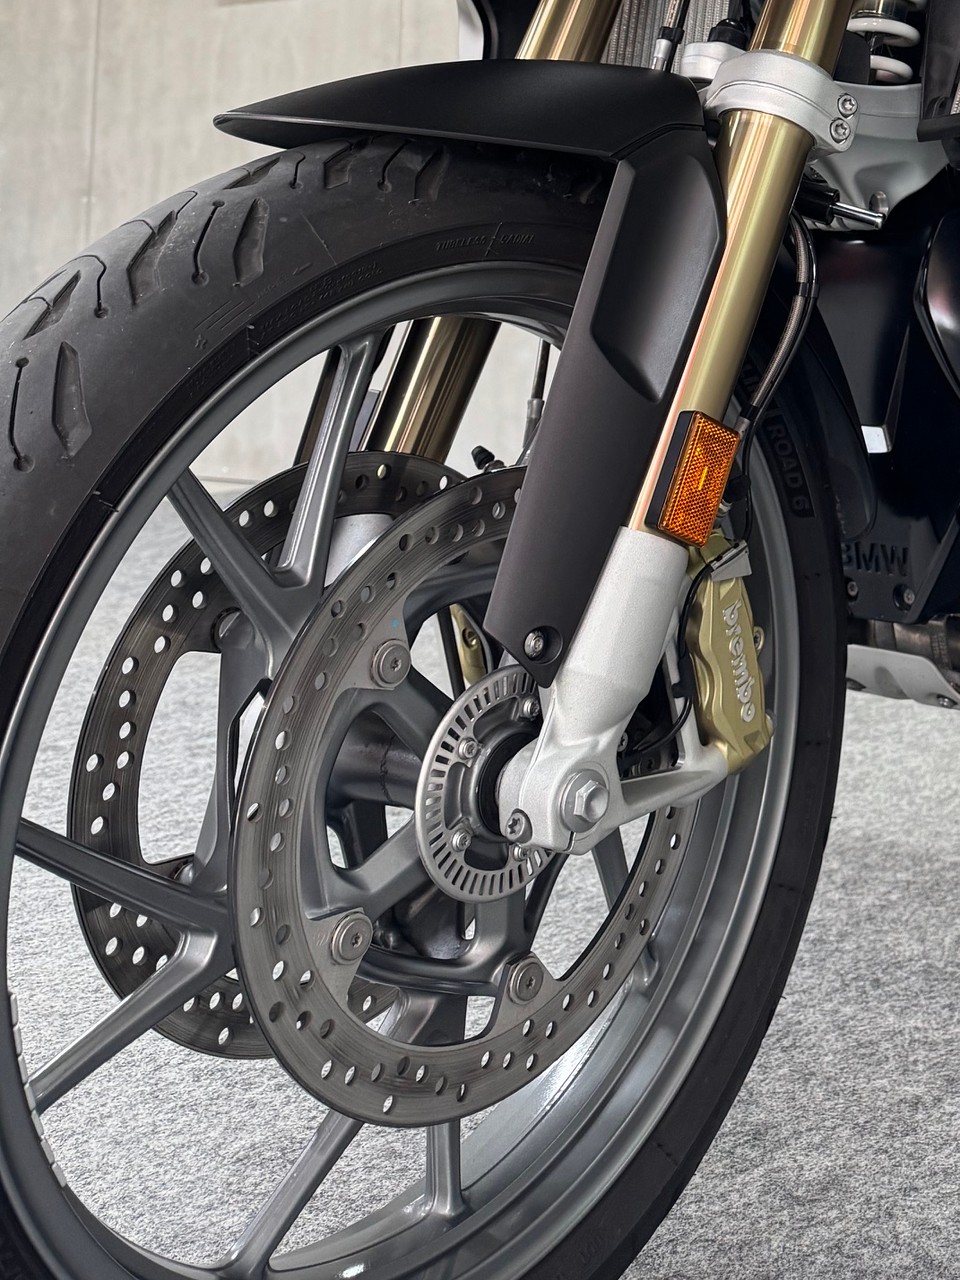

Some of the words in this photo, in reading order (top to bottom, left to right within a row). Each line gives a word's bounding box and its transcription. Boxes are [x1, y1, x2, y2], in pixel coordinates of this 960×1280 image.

[766, 424, 803, 489] ROAD
[792, 496, 810, 512] 6
[722, 599, 757, 723] brembo
